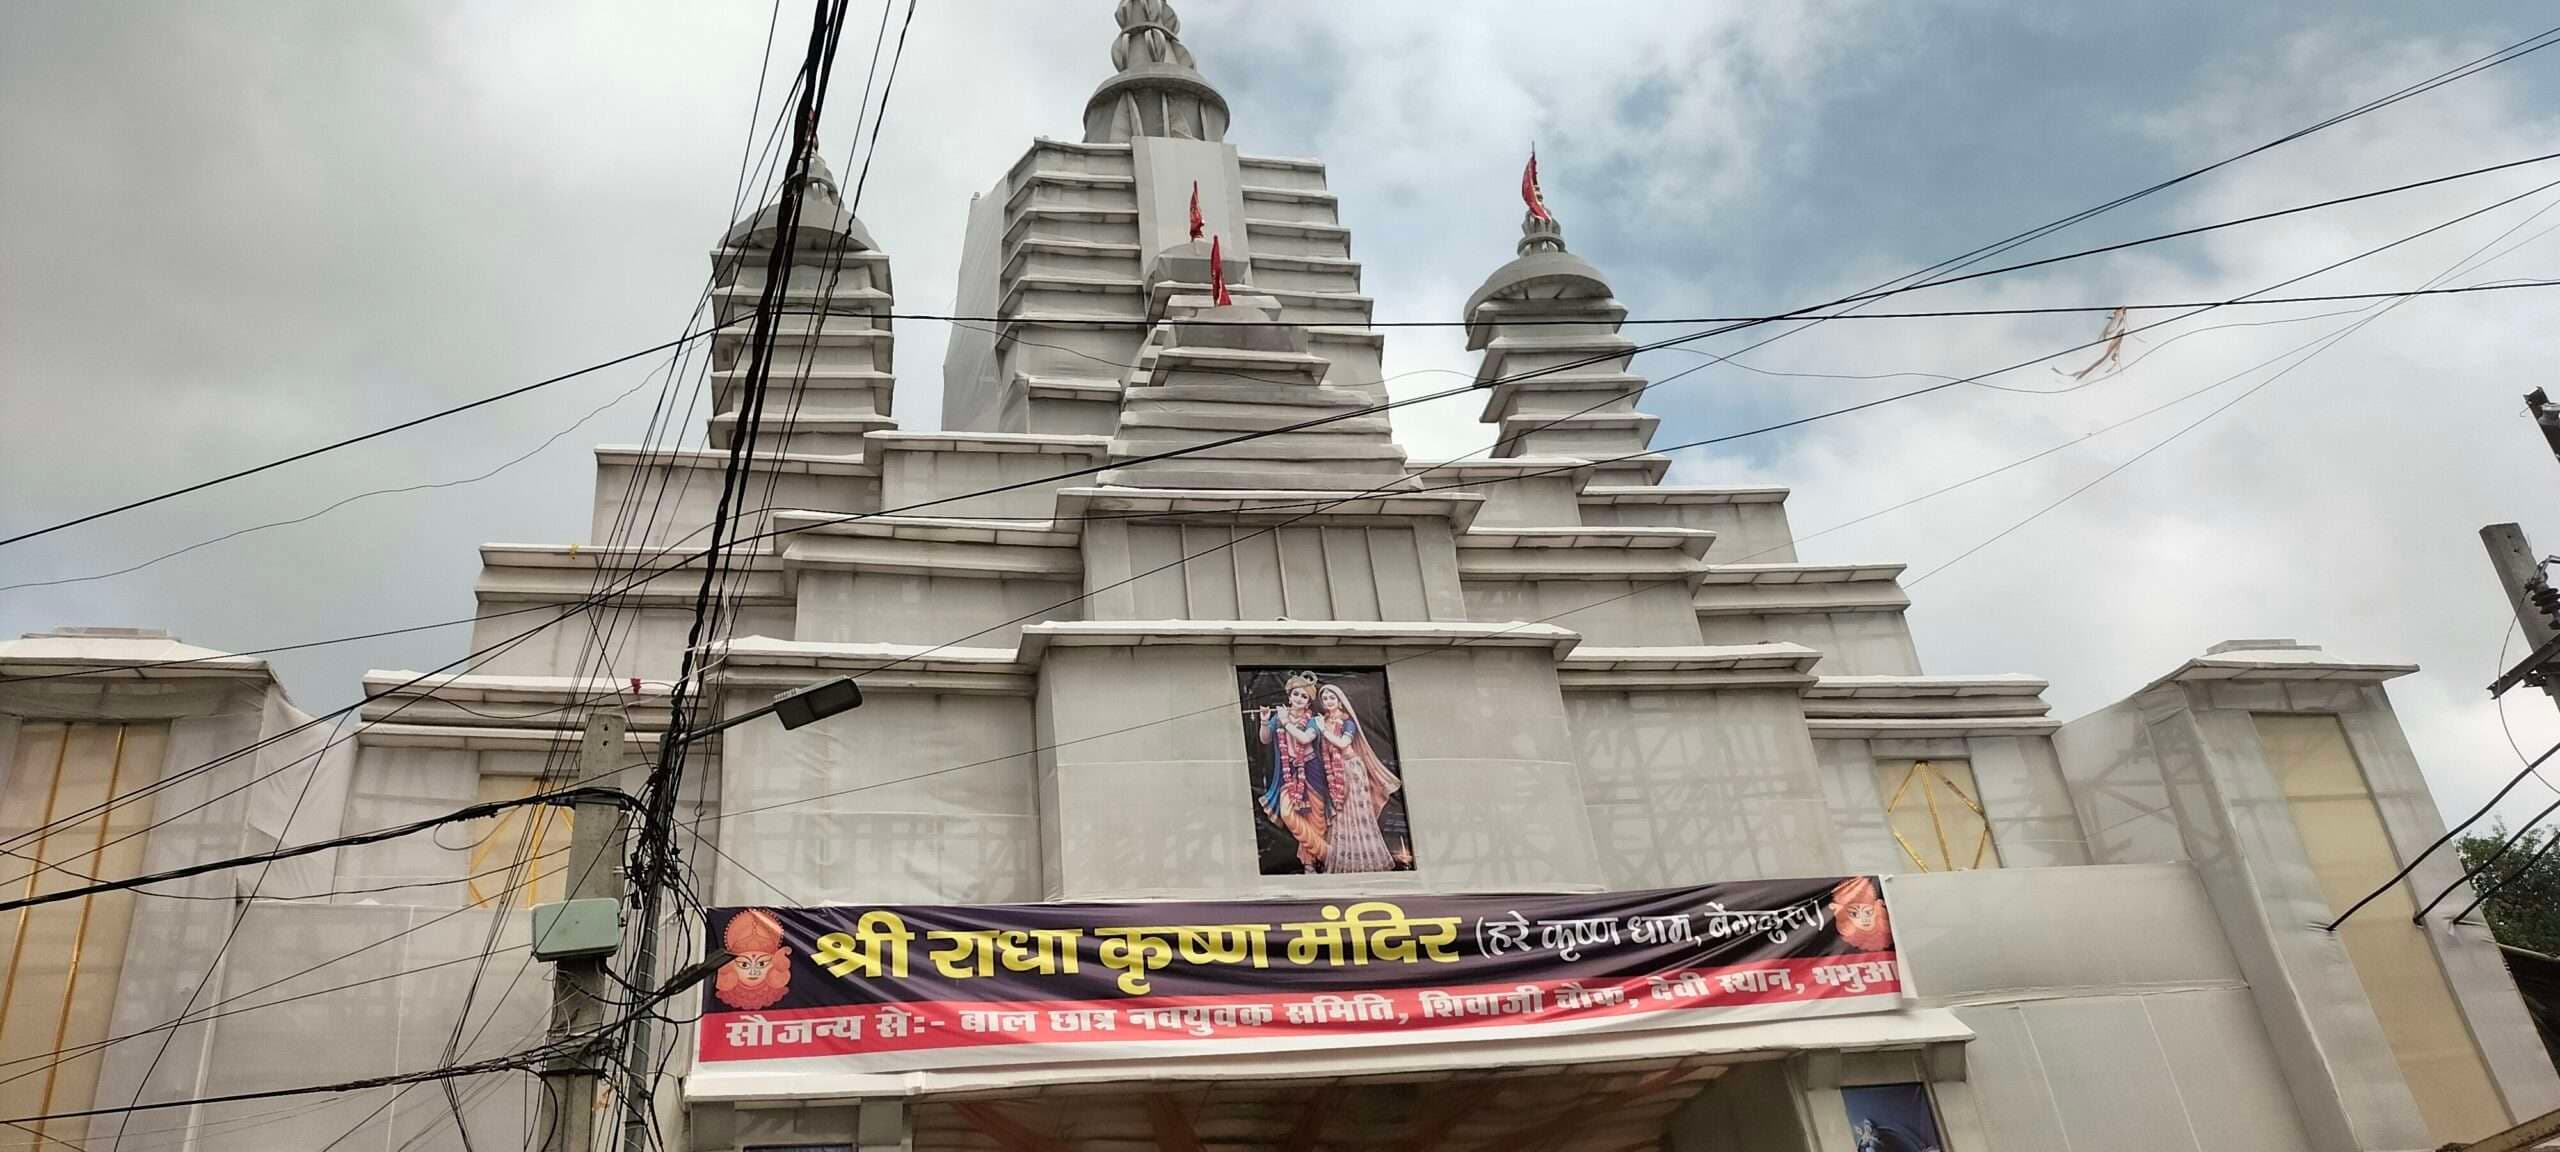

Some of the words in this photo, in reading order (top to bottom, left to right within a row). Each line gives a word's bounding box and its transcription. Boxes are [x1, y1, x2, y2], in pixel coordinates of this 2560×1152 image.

[810, 911, 915, 979] श्री
[927, 928, 1083, 978] राधा
[1094, 924, 1271, 995] कृष्ण
[1281, 902, 1462, 966] मंदिर
[1475, 910, 1533, 959] (हरे
[1537, 917, 1621, 962] कृष्ण
[1627, 914, 1702, 946] धाम,
[725, 1014, 865, 1047] सौजन्य
[959, 1010, 1039, 1032] बाल
[1048, 1009, 1117, 1032] छात्र
[1127, 1003, 1273, 1036] नवयुवक
[1282, 993, 1409, 1024] समिति,
[1418, 985, 1545, 1018] शिवाजी
[1554, 982, 1639, 1009] चौक,
[1647, 971, 1711, 999] देवी
[1715, 968, 1806, 994] स्थान,
[1811, 960, 1900, 993] भभुआ
